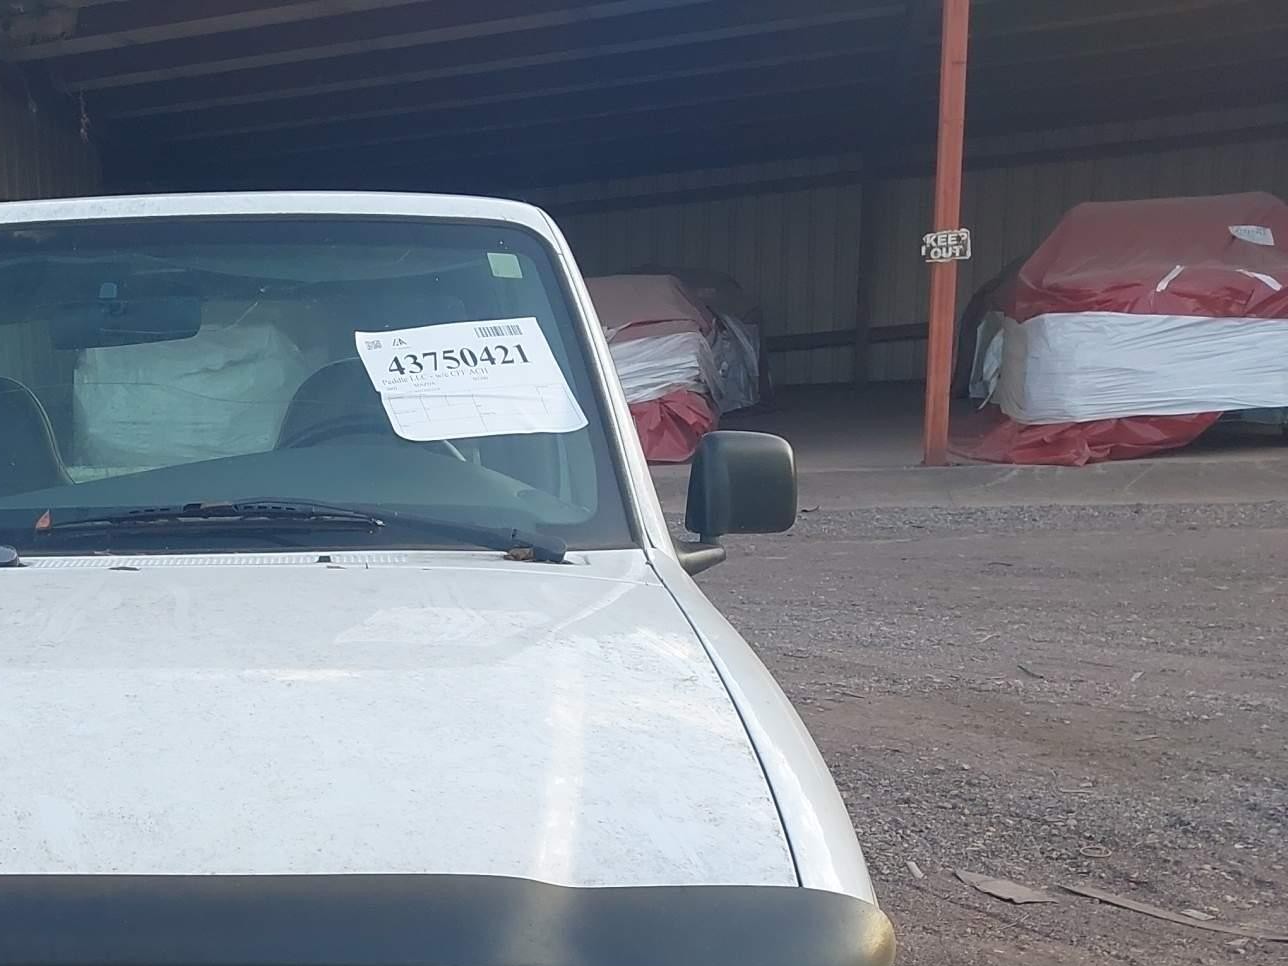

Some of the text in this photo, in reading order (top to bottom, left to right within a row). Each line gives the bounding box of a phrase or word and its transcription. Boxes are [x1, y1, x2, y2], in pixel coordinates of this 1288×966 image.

[925, 232, 968, 247] KEEP
[930, 245, 963, 259] OUT
[388, 343, 531, 375] 43750421
